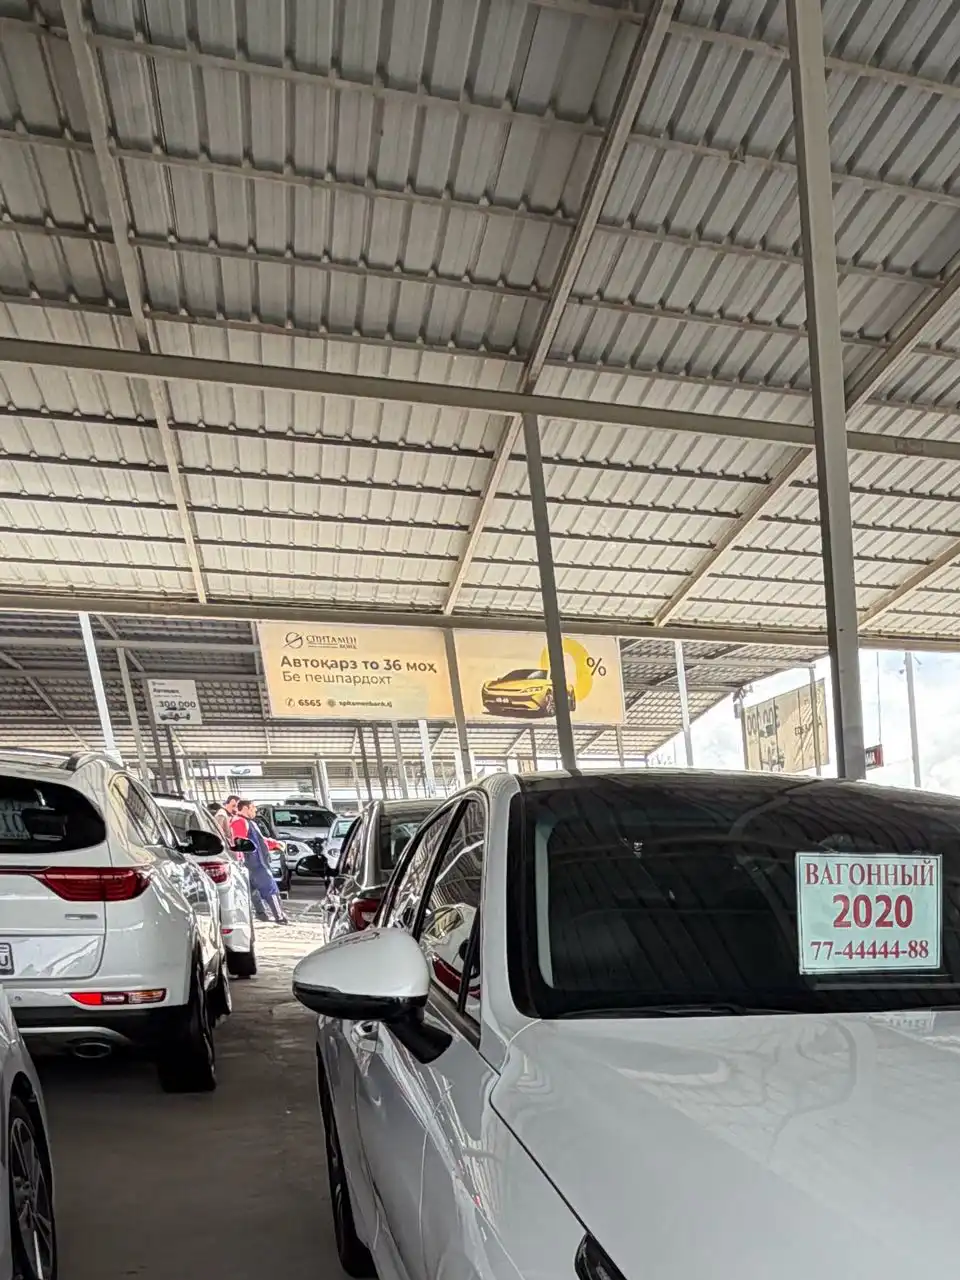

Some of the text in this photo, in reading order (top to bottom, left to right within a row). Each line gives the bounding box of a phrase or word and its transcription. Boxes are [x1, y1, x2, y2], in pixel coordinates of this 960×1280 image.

[280, 655, 358, 671] Автоқарз
[361, 659, 380, 670] то
[383, 659, 402, 671] 36
[282, 671, 392, 686] Бе пешпардохт
[298, 699, 322, 707] 6565
[804, 859, 935, 887] ВАГОННЫЙ
[832, 894, 913, 929] 2020
[810, 939, 929, 961] 77-44444-88
